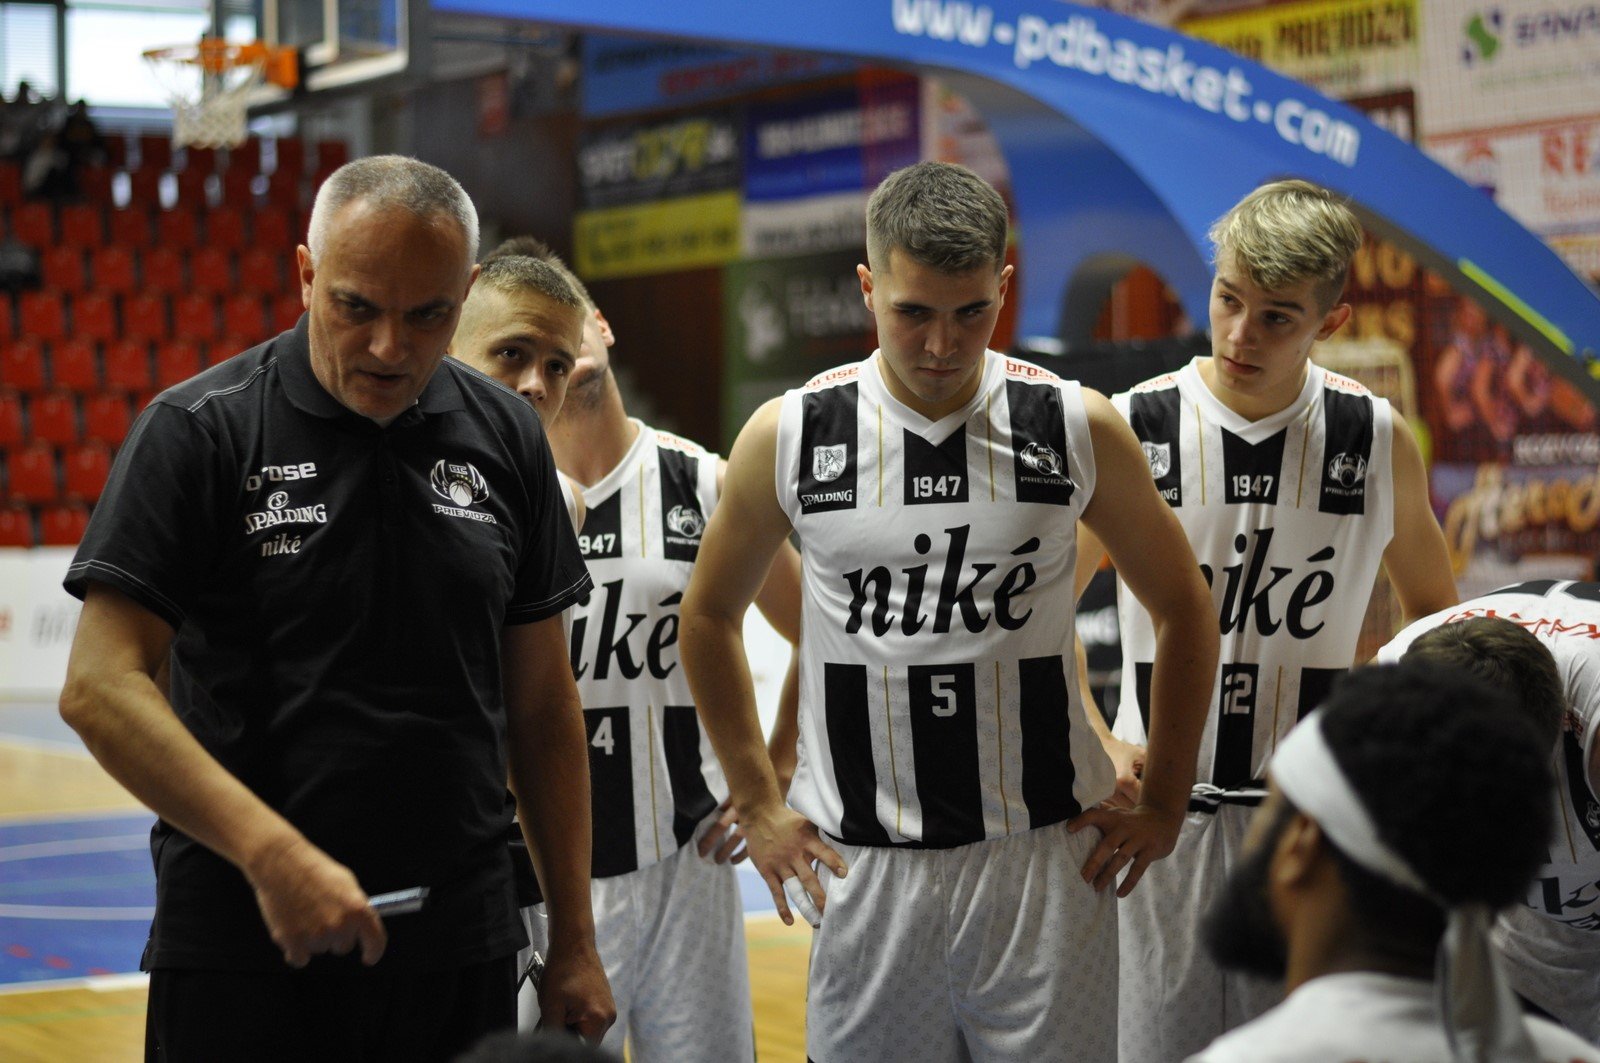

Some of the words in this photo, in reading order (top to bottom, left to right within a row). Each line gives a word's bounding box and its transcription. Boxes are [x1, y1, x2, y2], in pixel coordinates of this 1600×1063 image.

[246, 462, 317, 492] bose
[449, 464, 468, 475] BC
[801, 489, 853, 506] SPALDING
[913, 475, 962, 498] 1947
[1232, 474, 1274, 498] 1947
[246, 503, 328, 534] SPALDING
[432, 503, 497, 524] PRIEVIDZA
[261, 532, 302, 557] niké
[578, 533, 616, 554] 947
[842, 523, 1041, 637] niké
[1199, 526, 1335, 640] iké
[570, 578, 683, 681] iké
[930, 674, 957, 717] 5
